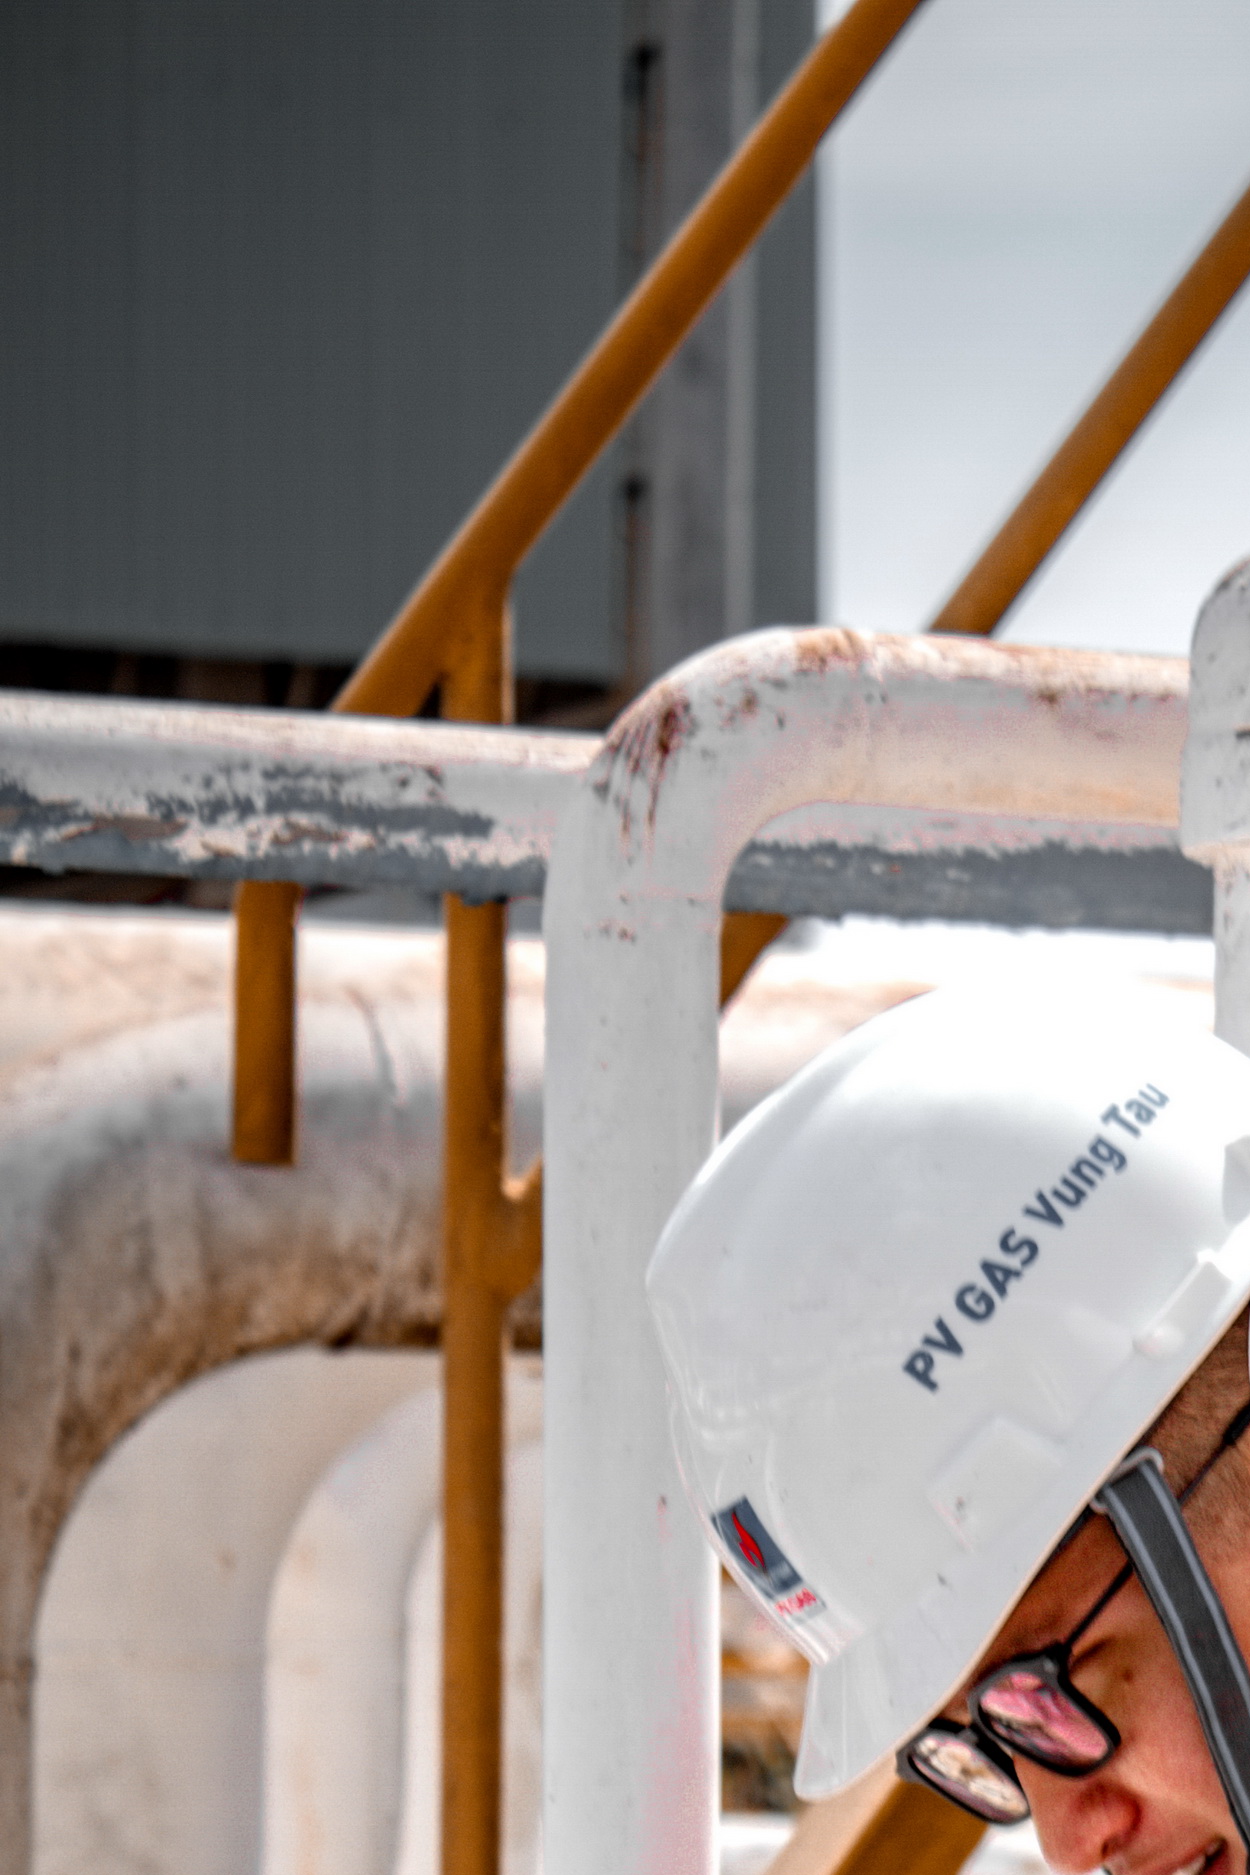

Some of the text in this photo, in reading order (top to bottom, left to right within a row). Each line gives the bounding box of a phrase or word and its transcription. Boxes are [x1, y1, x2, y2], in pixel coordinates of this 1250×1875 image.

[902, 1082, 1171, 1392] PV GAS Vung Tau
